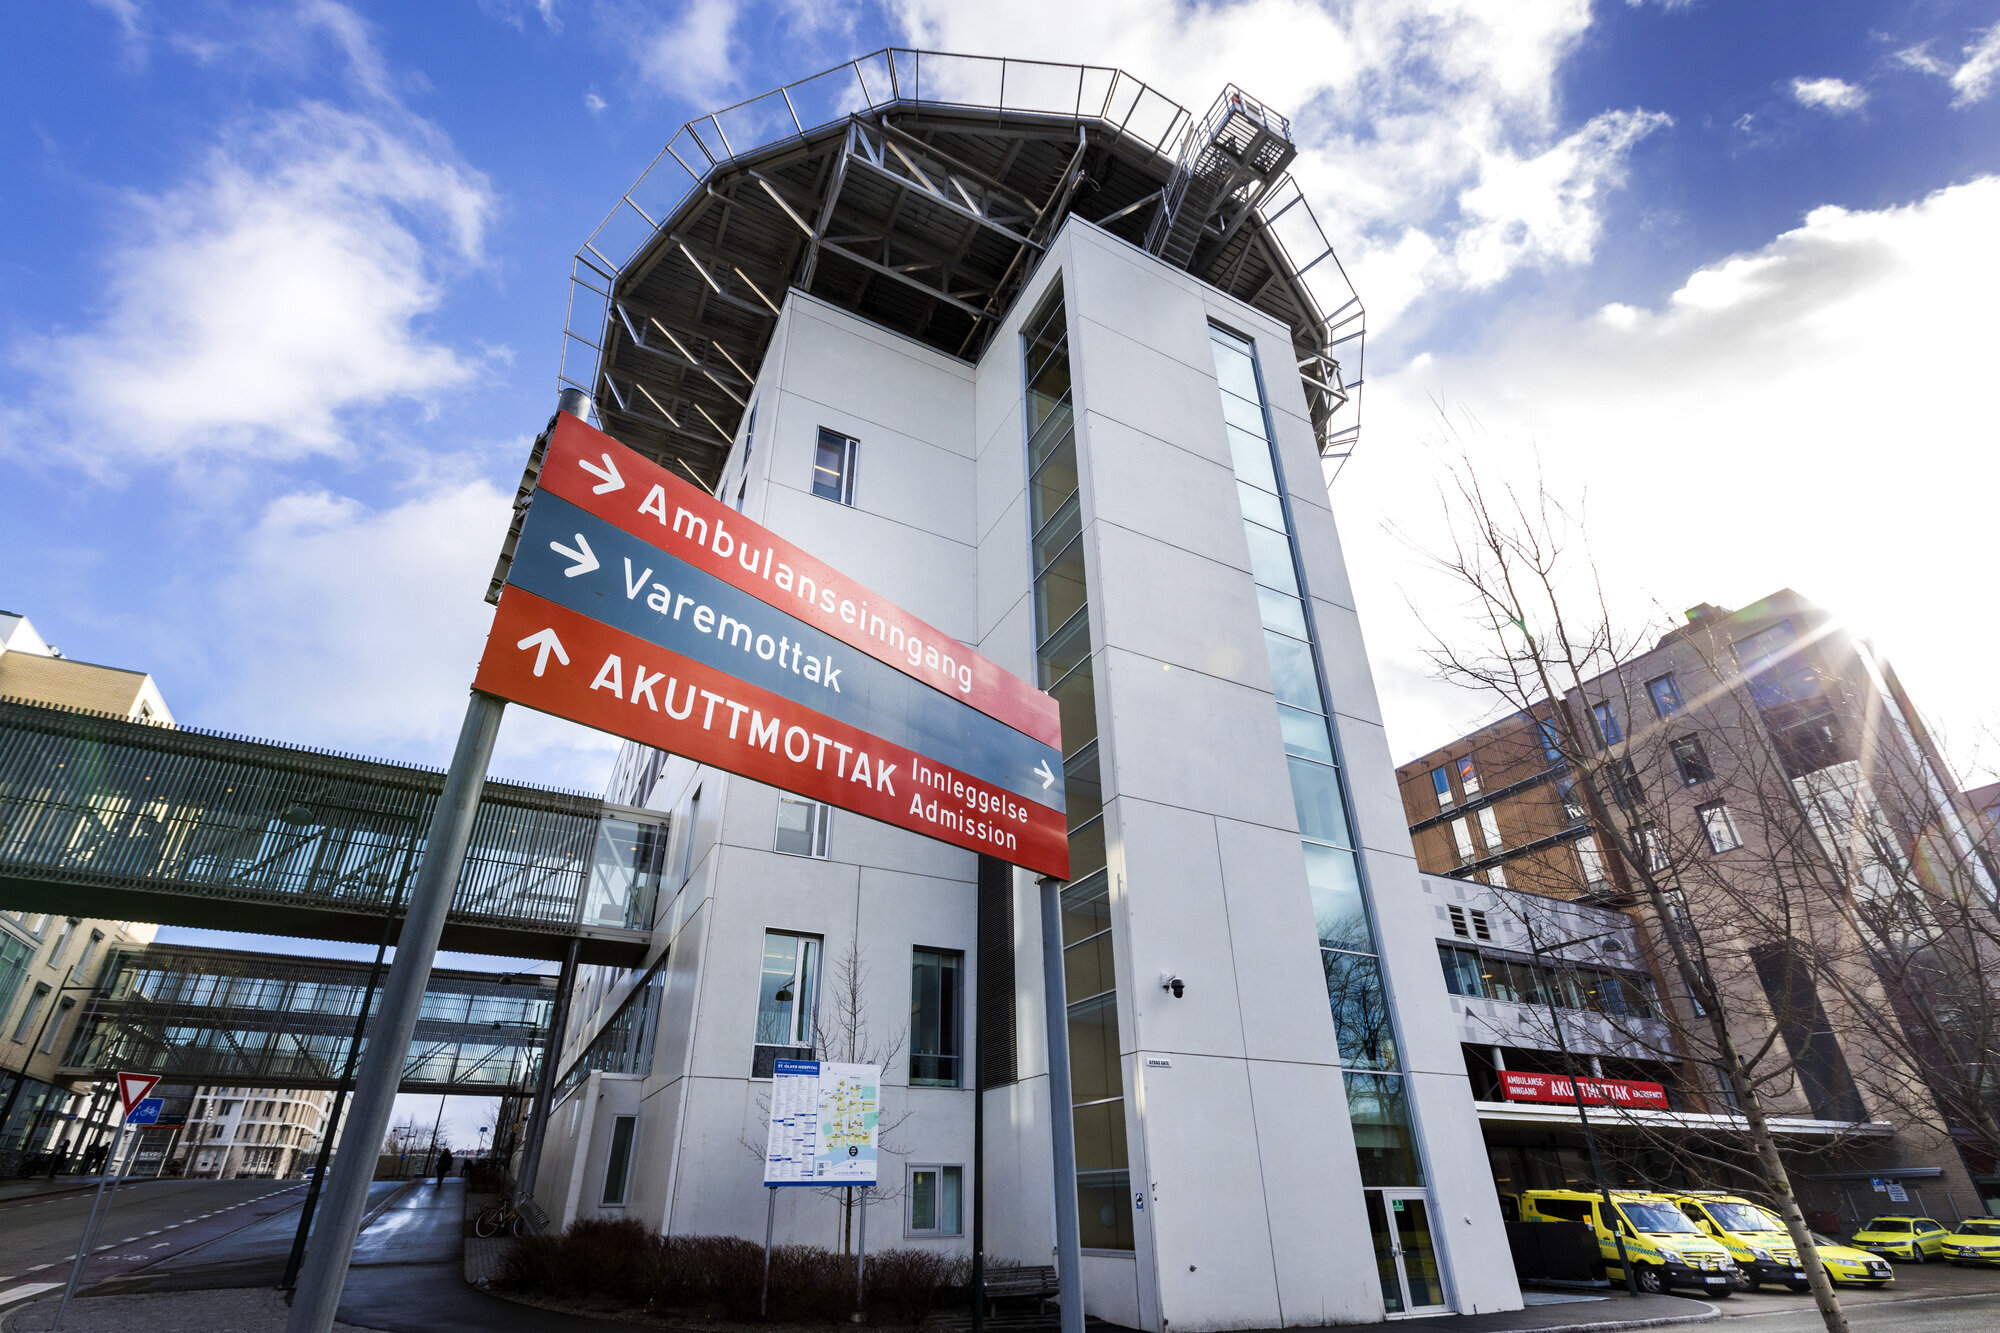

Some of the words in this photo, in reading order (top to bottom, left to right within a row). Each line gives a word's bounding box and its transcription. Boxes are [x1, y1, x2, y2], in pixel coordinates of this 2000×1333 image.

[637, 484, 975, 694] Ambulanseinngang
[623, 556, 844, 694] Varemottak
[589, 653, 898, 797] AKUTTMOTTAK
[909, 793, 1018, 852] Admission
[912, 757, 1029, 824] Innleggelse
[1507, 1075, 1546, 1087] AMBULANSE-
[1509, 1086, 1537, 1096] INNGANG
